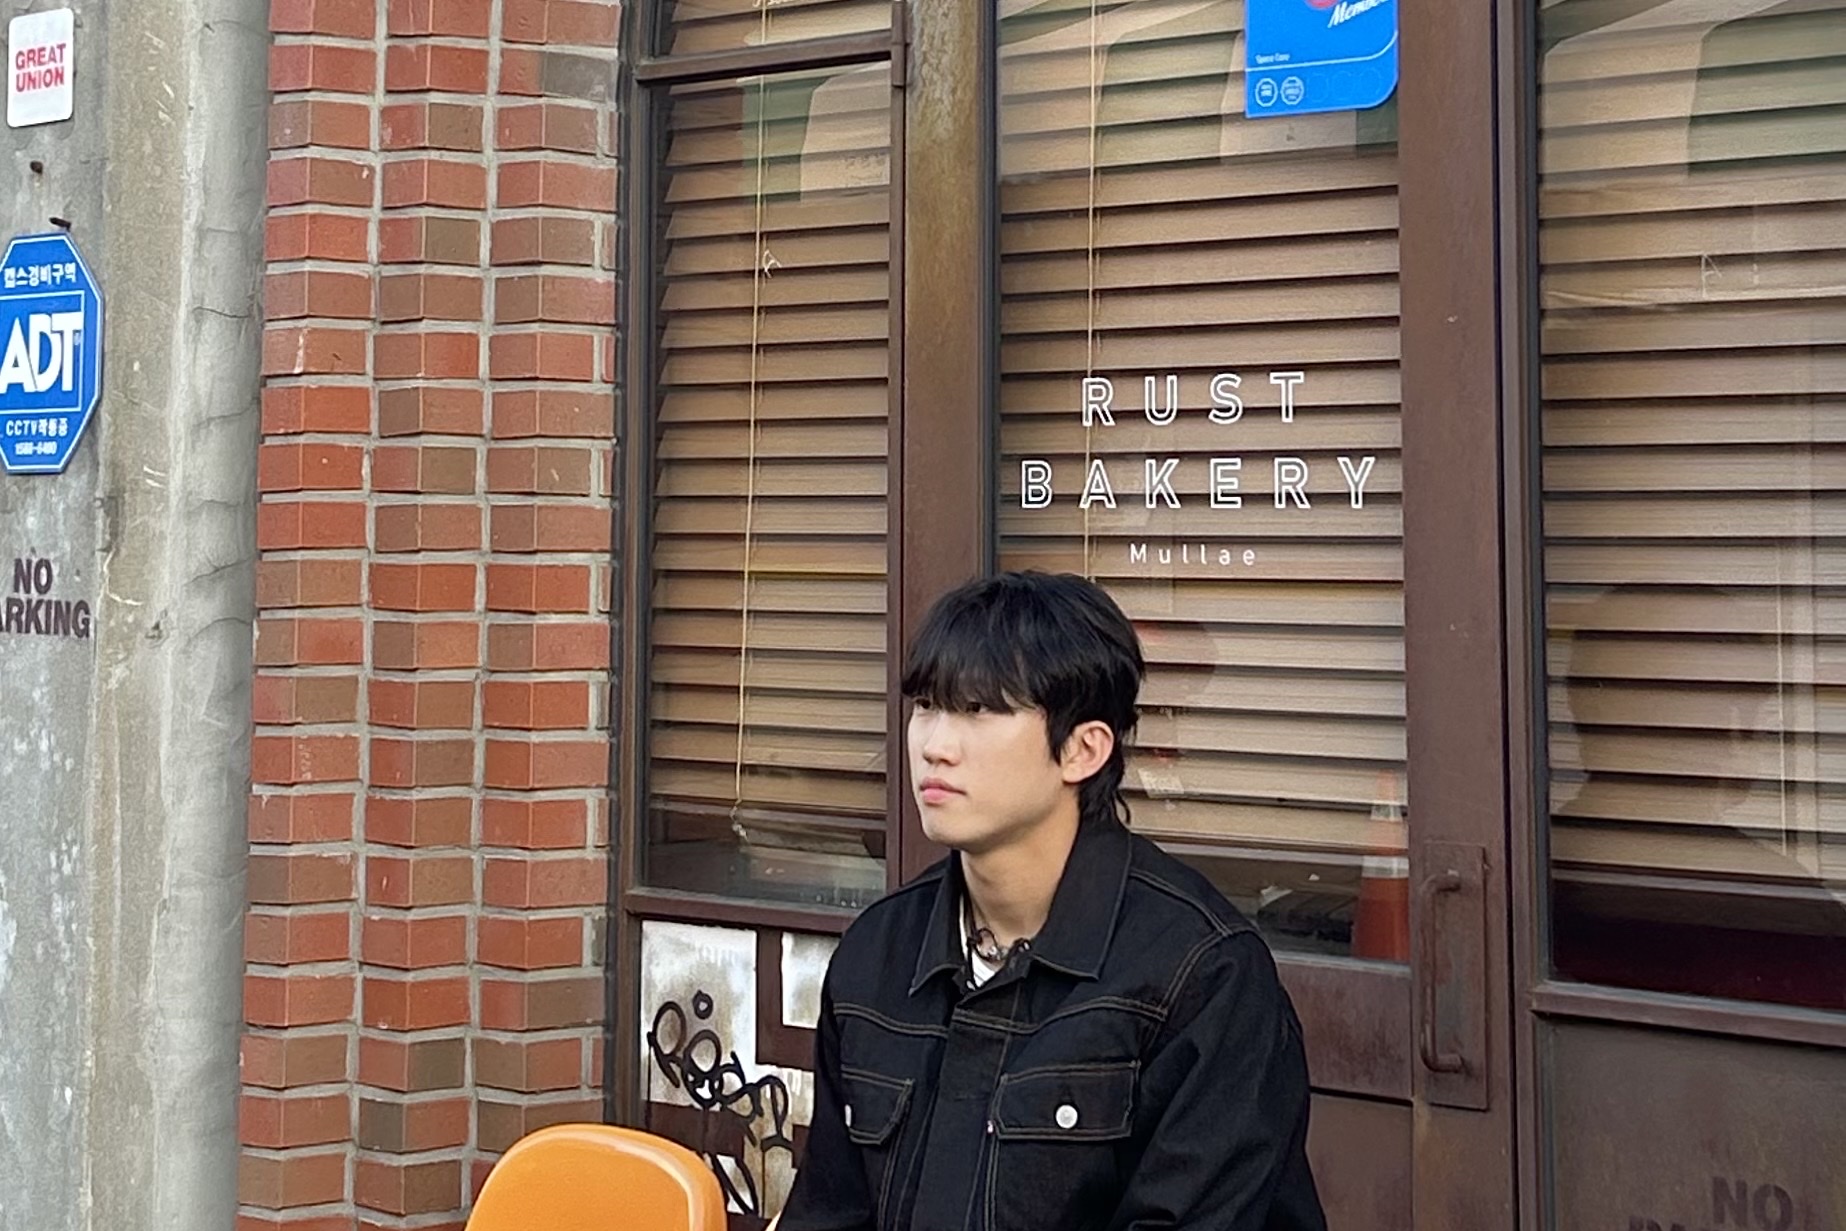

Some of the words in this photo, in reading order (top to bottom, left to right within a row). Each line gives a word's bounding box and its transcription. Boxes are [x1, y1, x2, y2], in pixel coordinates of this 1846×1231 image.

[15, 43, 67, 71] GREAT
[16, 66, 65, 93] UNION
[0, 312, 83, 393] ADT
[1082, 372, 1304, 427] RUST
[1021, 456, 1375, 509] BAKERY
[1130, 544, 1255, 566] Mullae
[14, 558, 53, 595] NO
[0, 597, 91, 639] RKING
